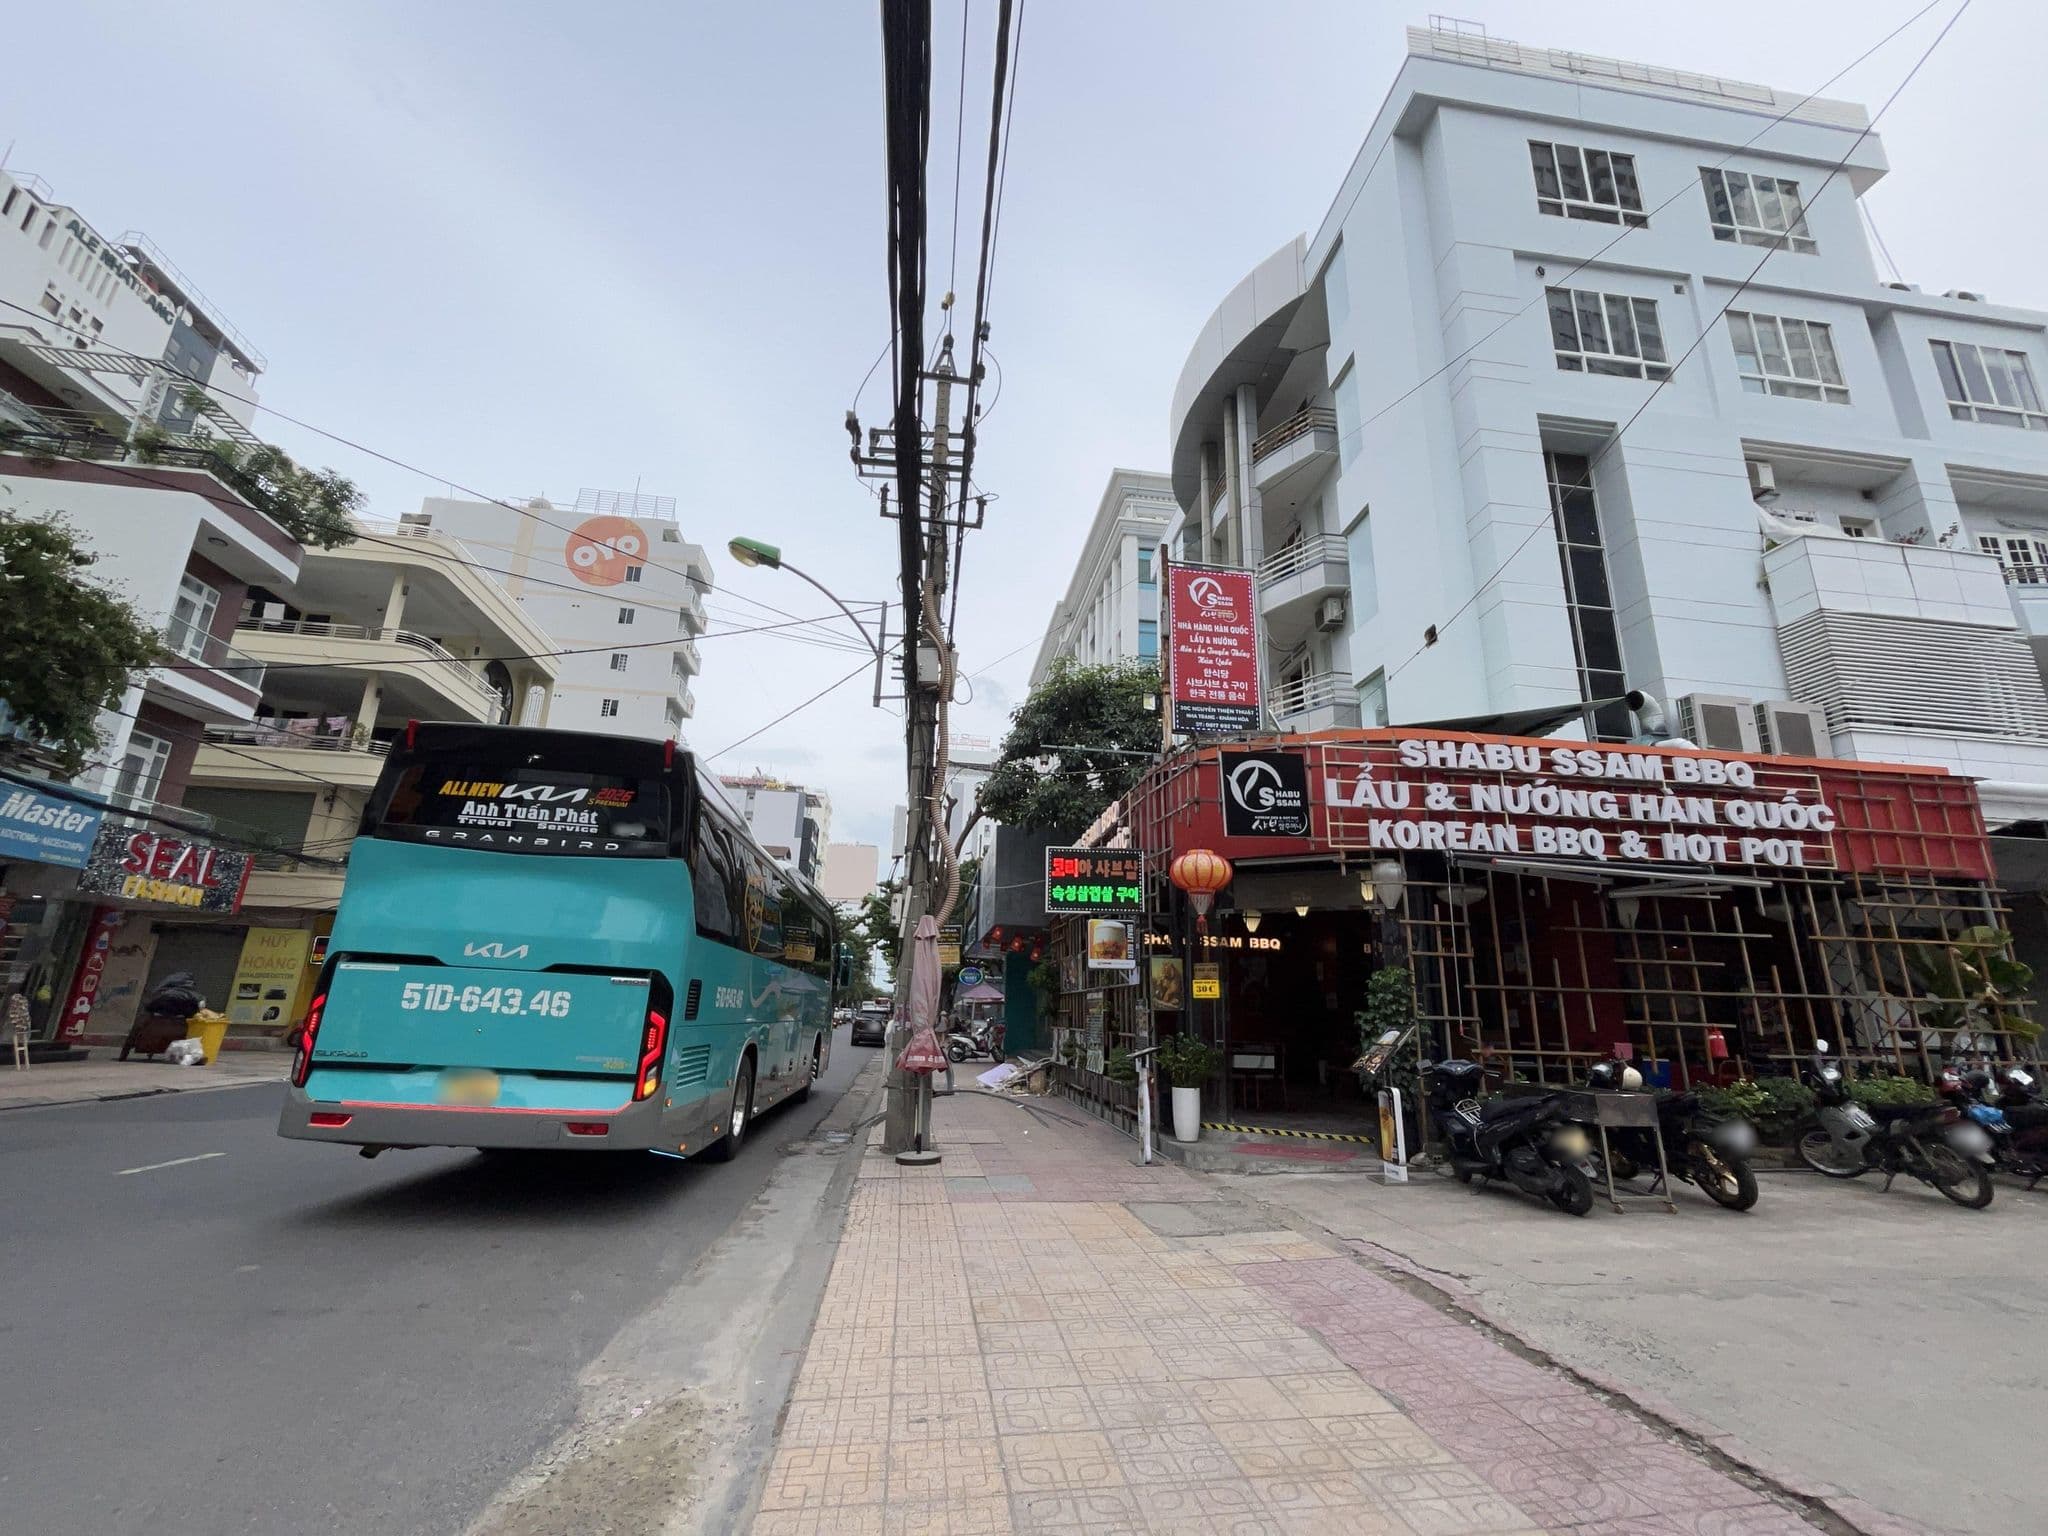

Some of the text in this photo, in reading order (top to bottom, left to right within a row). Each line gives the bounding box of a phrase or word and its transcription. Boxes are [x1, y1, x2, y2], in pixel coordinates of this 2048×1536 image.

[1177, 621, 1249, 635] NHÀ HÀNG HÀN QUỐC
[1205, 636, 1211, 644] &
[1203, 668, 1229, 679] 한식당
[1189, 689, 1246, 701] 한국 전통 음식
[1222, 681, 1229, 689] &
[1231, 681, 1248, 691] 구이
[1399, 740, 1756, 789] SHABU SSAM BBQ
[438, 780, 467, 796] ALL
[467, 782, 504, 798] NEW
[1326, 762, 1836, 832] LẨU & NƯỚNG HÀN QUỐC
[0, 792, 95, 832] Master
[461, 801, 598, 824] Anh Tuấn Phát
[458, 817, 598, 834] Travel Service
[425, 830, 619, 851] GRANBIRD
[1368, 819, 1804, 866] KOREAN BBQ & HOT POT
[120, 832, 220, 888] SEAL
[1051, 857, 1093, 878] 코리아
[121, 875, 205, 906] FASHION
[1116, 886, 1139, 903] 구이
[1249, 937, 1281, 950] BBQ
[401, 982, 571, 1017] 51D-643.46
